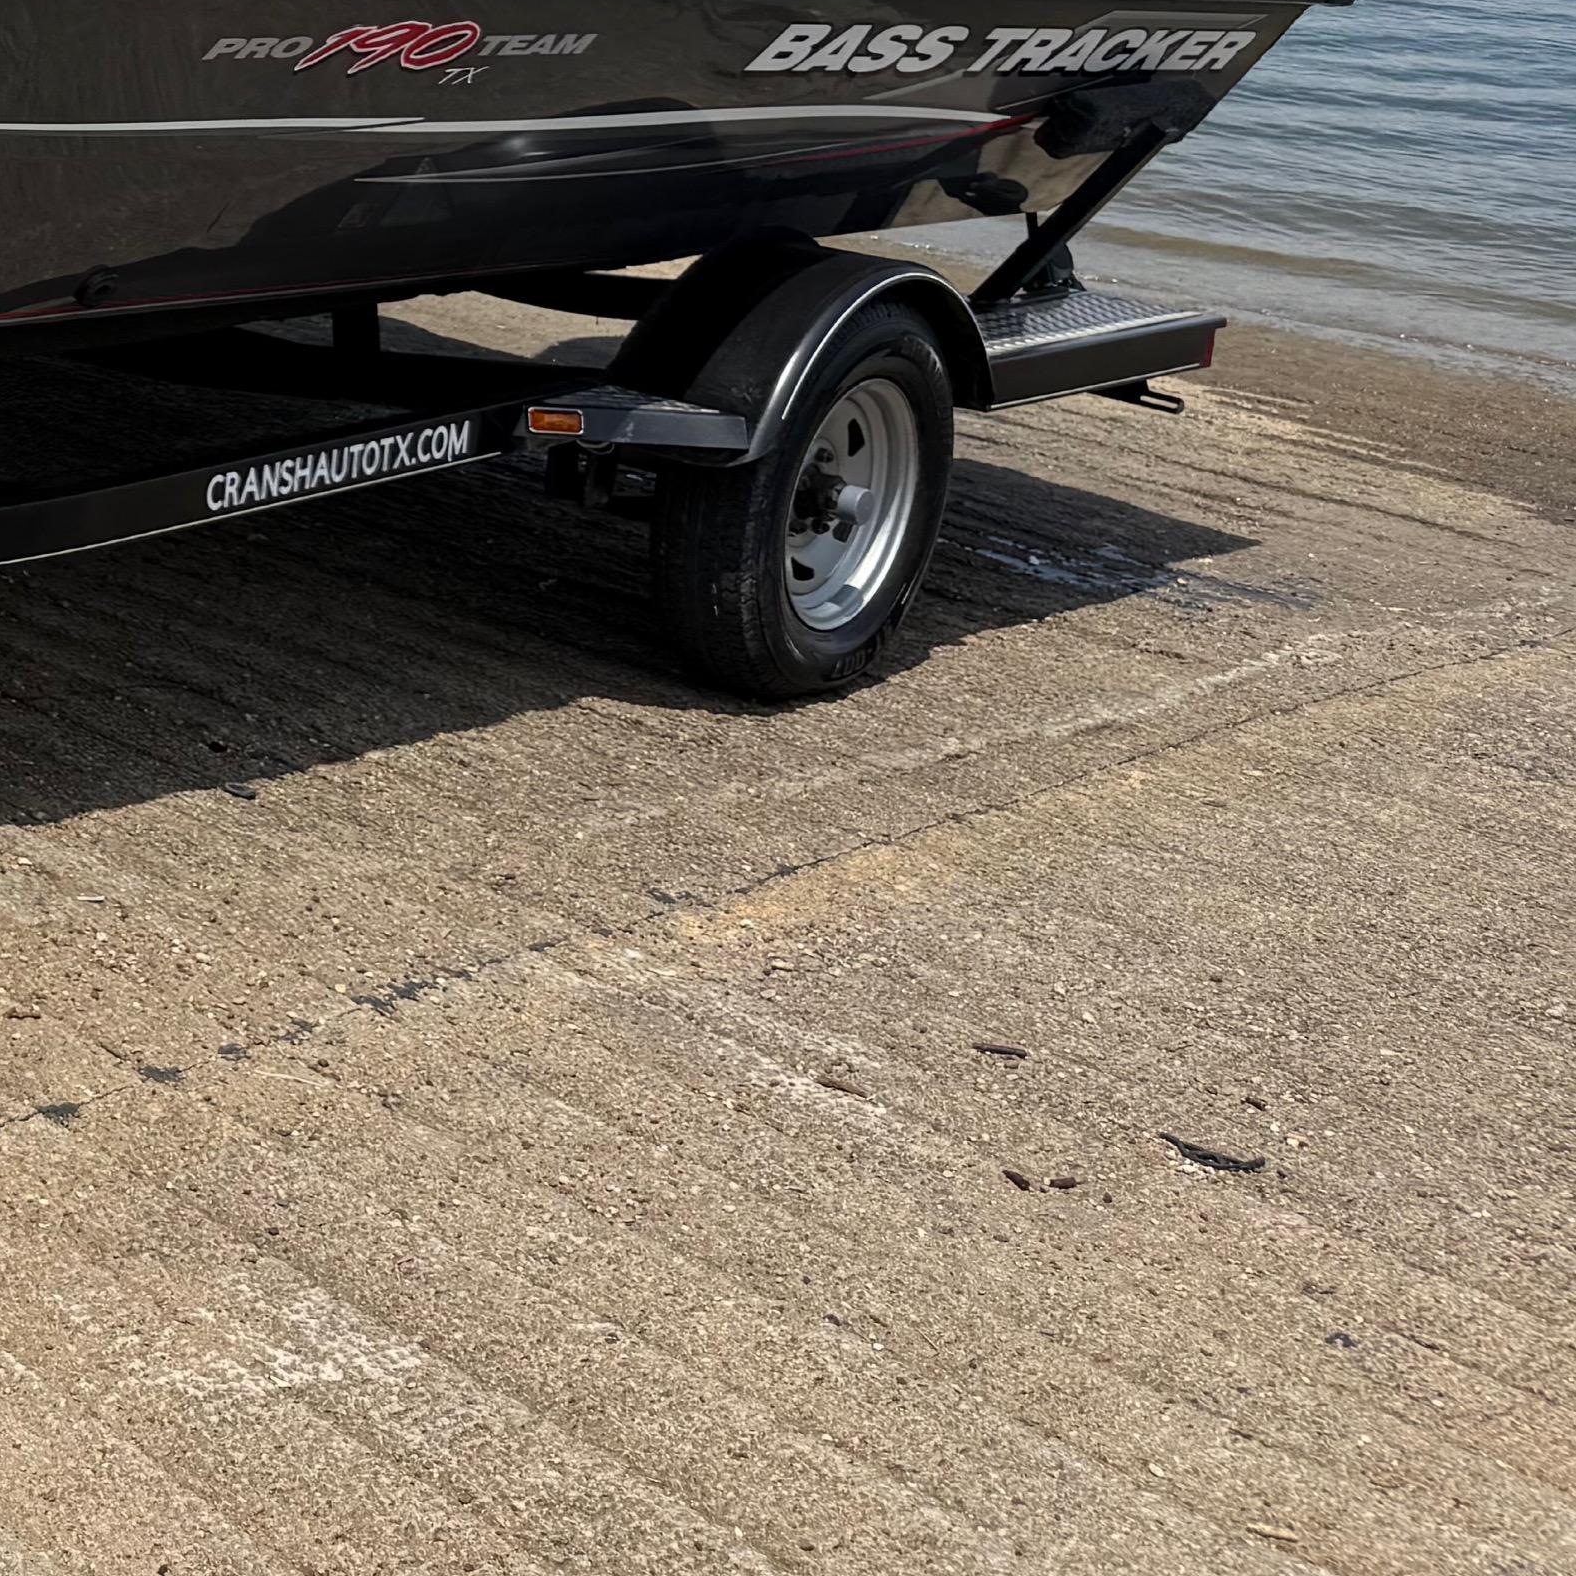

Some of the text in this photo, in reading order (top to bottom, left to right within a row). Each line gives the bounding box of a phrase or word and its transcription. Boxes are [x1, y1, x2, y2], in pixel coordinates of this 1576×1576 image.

[202, 20, 598, 75] PRO 190 TEAM
[743, 24, 1257, 73] BASS TRACKER
[437, 65, 491, 85] TX
[205, 420, 471, 512] CRANSHAUTOTX.COM
